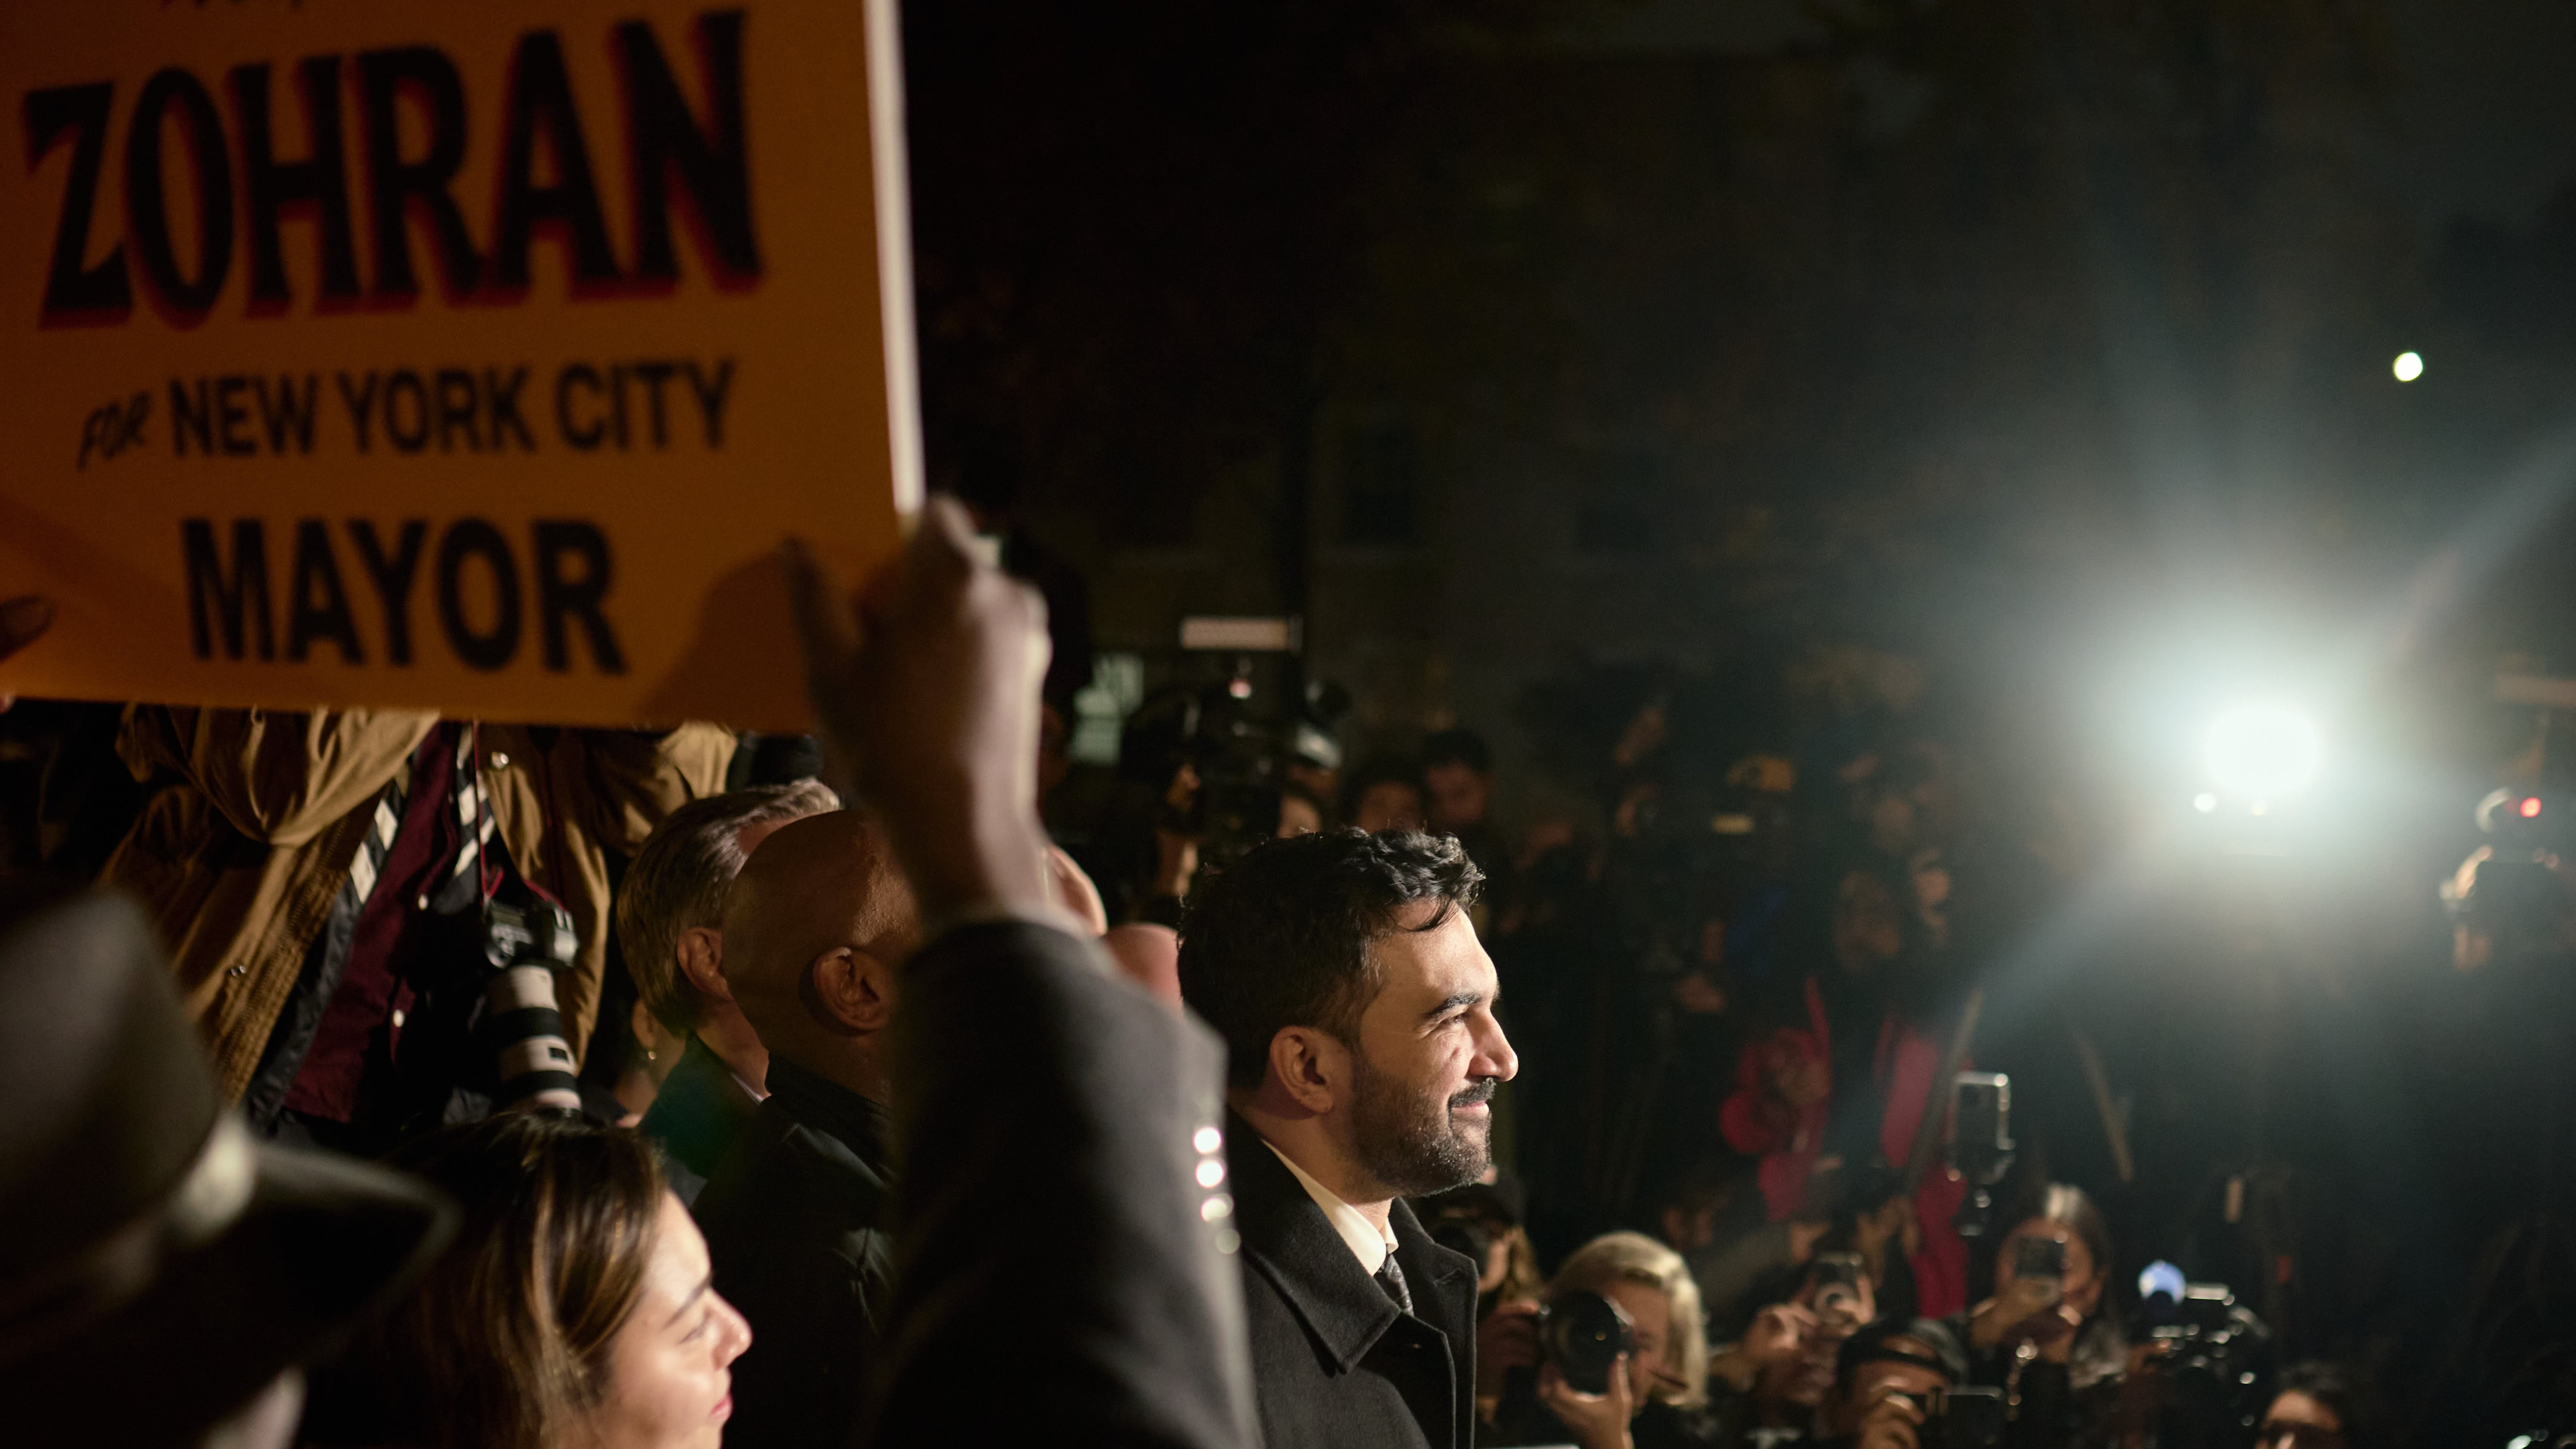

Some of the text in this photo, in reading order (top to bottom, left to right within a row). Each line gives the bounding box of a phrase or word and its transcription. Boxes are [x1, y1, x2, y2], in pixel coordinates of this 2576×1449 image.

[21, 10, 765, 331] ZOHRAN
[77, 361, 737, 471] FOR NEW YORK CITY
[182, 518, 626, 674] MAYOR
